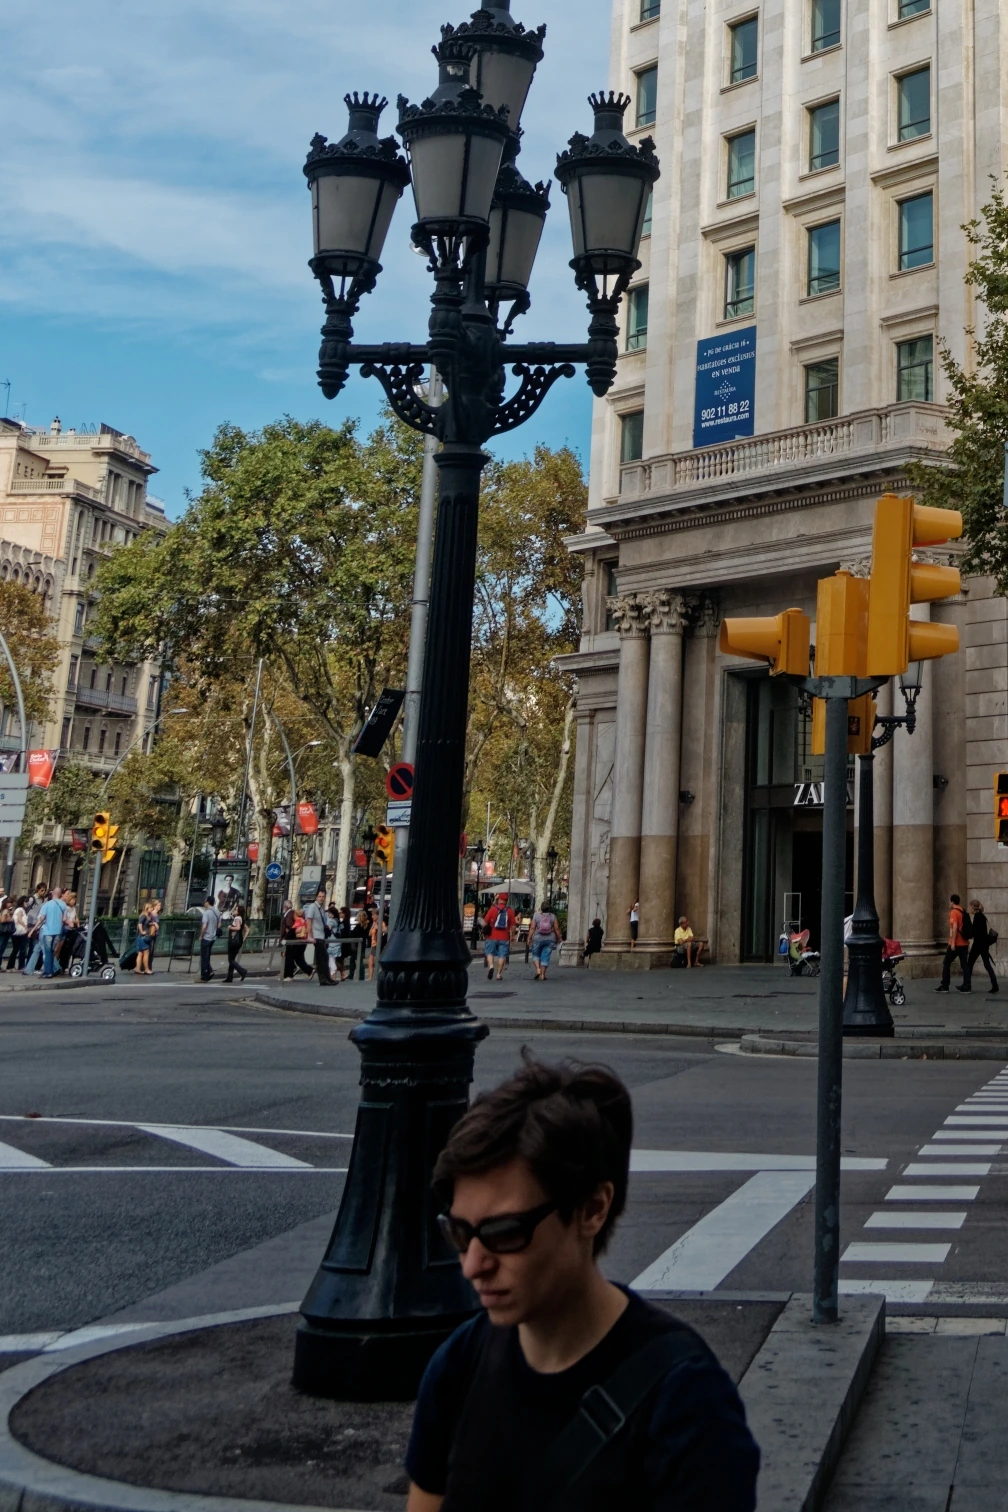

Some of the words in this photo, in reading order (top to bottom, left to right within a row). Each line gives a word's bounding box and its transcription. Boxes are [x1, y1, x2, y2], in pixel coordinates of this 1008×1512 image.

[701, 408, 716, 420] 902
[717, 405, 726, 417] 11
[728, 402, 738, 415] 88
[740, 399, 750, 412] 22
[701, 412, 750, 428] www.restaura.com
